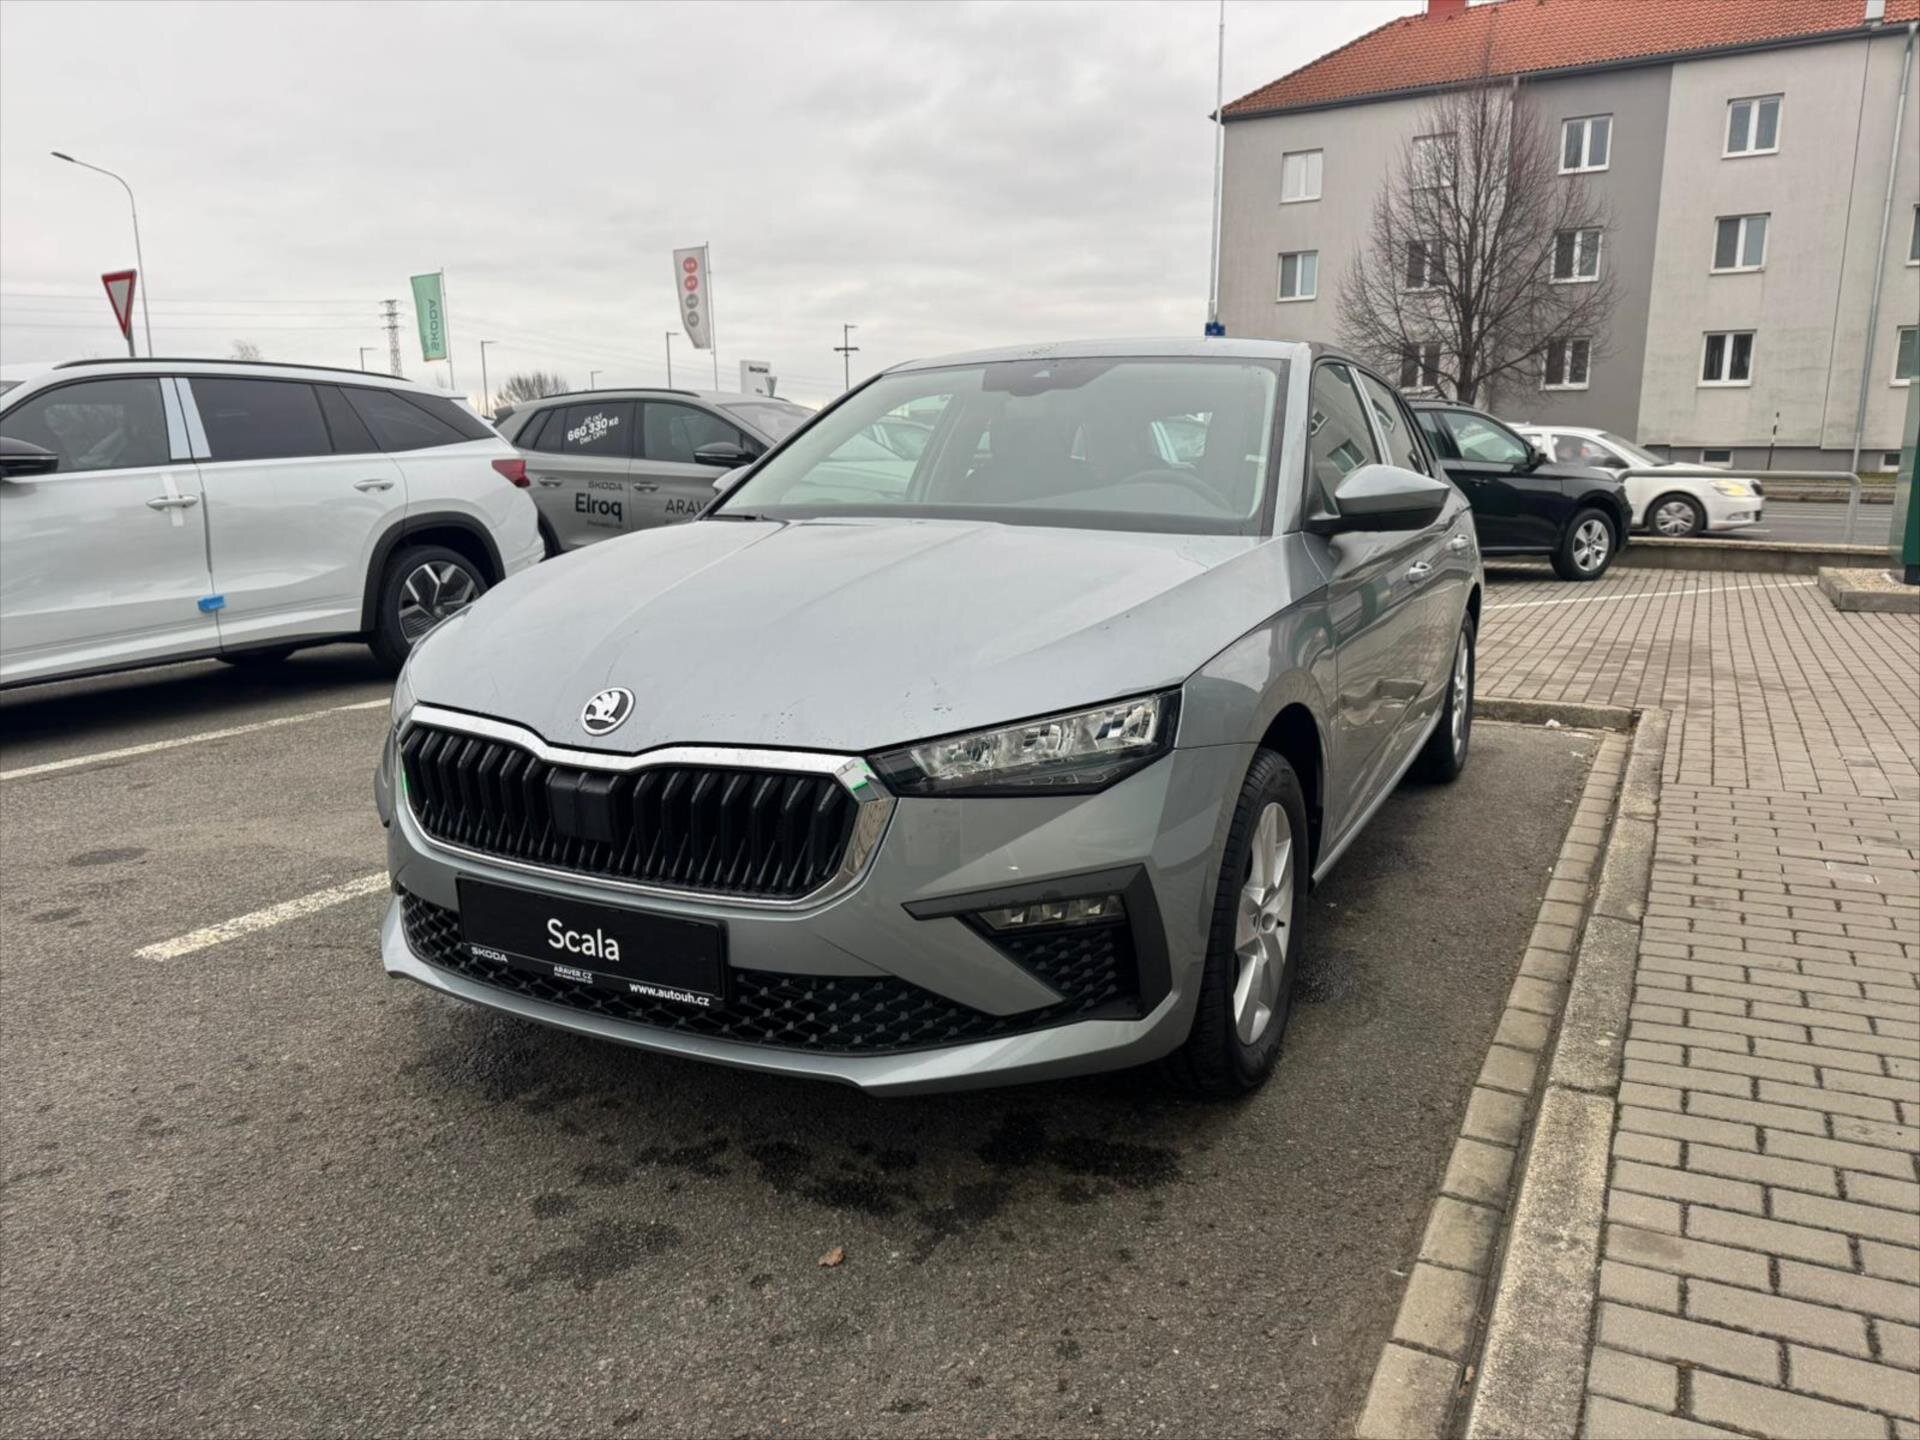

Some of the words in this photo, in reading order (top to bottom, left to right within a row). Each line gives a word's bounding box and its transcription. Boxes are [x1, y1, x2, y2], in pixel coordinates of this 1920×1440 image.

[567, 426, 587, 442] 660
[588, 418, 608, 433] 330
[575, 492, 622, 522] Elroq
[547, 917, 620, 962] Scala
[553, 965, 581, 977] ARAVER
[582, 971, 593, 980] CZ
[629, 983, 710, 1007] www.autouh.cz
